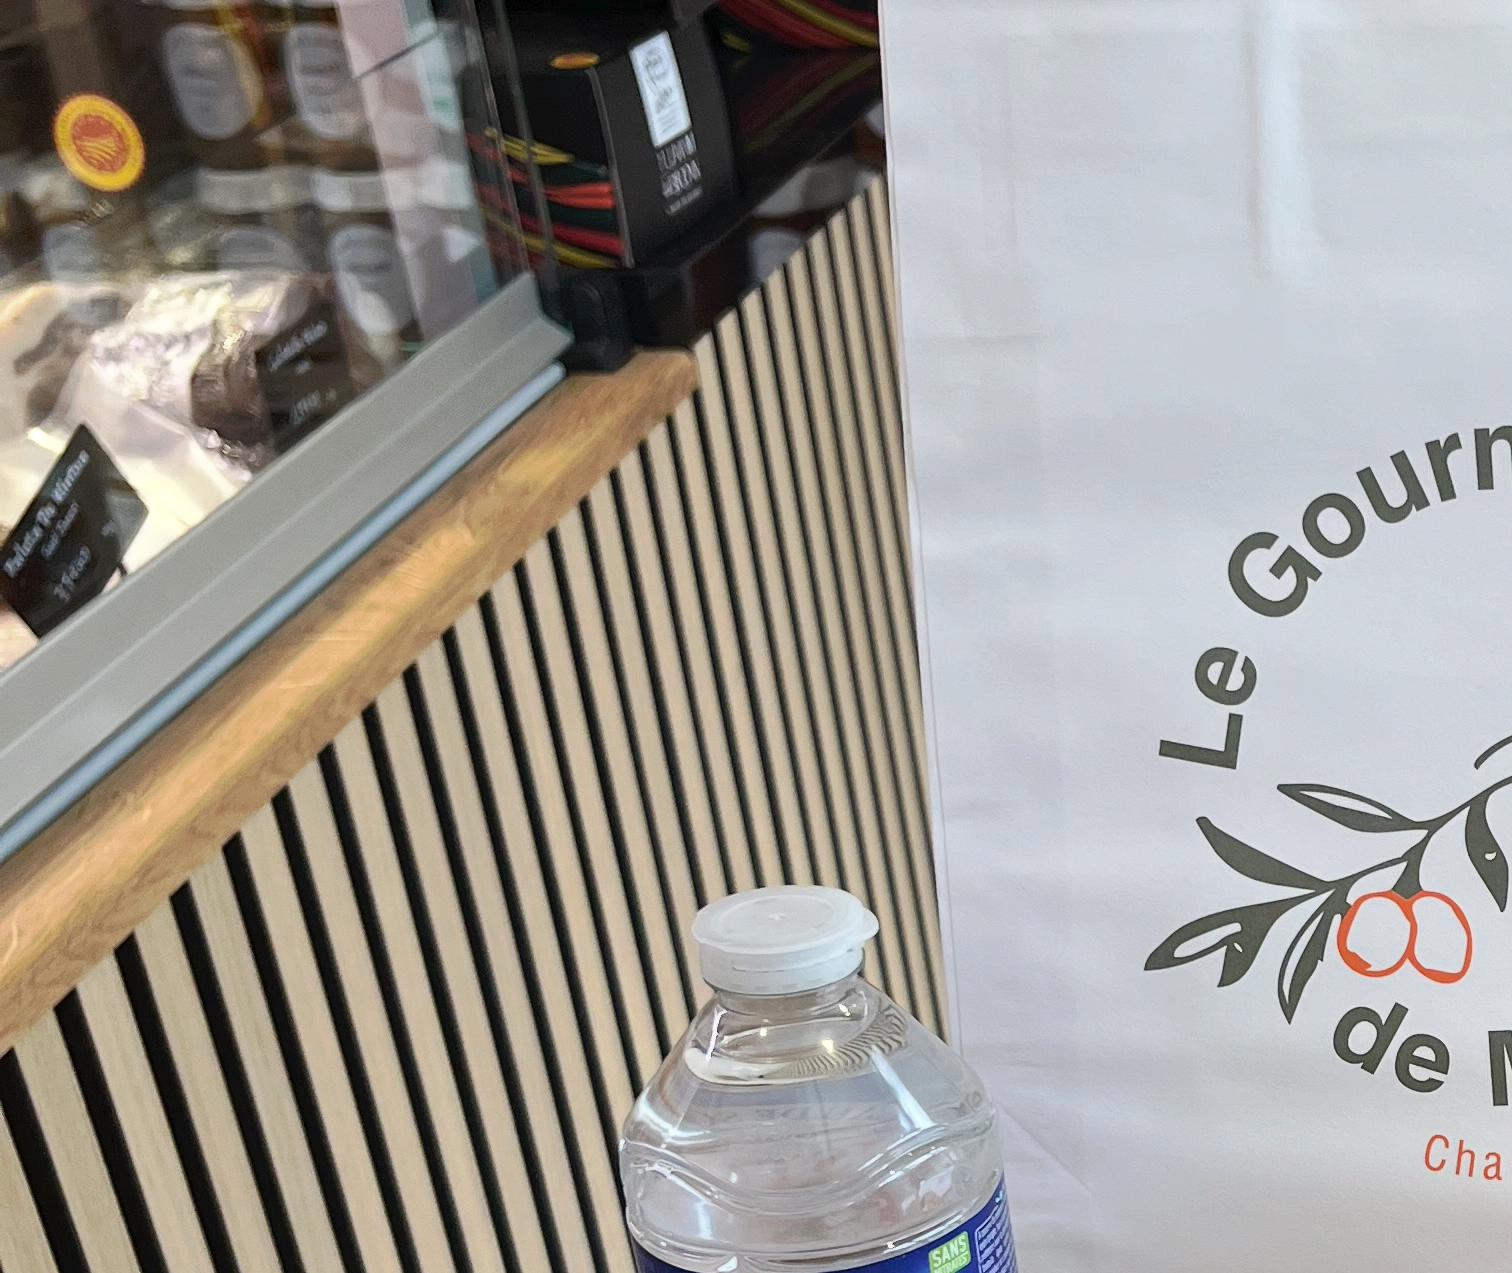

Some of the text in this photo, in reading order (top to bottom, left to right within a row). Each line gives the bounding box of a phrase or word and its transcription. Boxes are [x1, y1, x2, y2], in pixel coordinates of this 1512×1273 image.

[1158, 646, 1258, 770] Le
[1332, 1002, 1451, 1095] de
[932, 1234, 967, 1268] SANS
